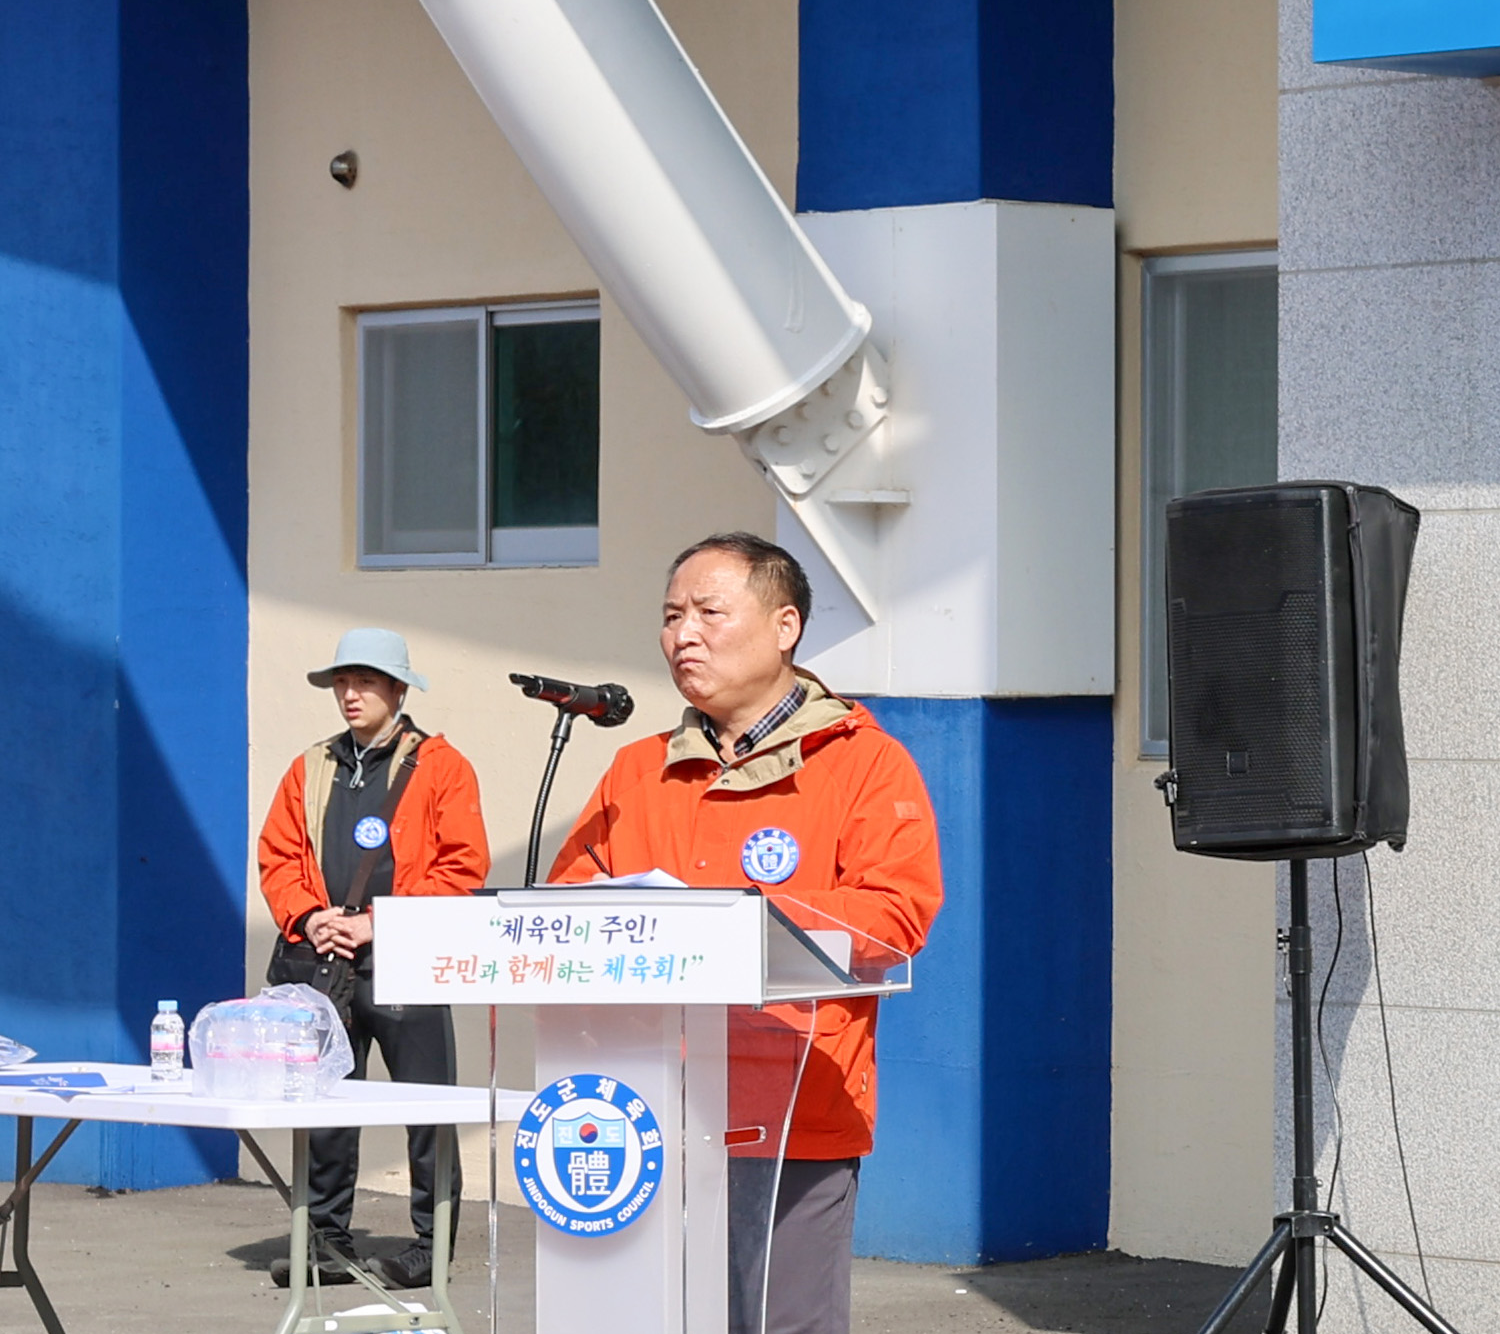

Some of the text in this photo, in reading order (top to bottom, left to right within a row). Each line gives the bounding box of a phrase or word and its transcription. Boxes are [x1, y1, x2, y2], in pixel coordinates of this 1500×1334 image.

[600, 915, 658, 945] 주인!
[431, 954, 499, 985] 군민과
[507, 953, 595, 986] 함께하는
[568, 1150, 611, 1196] 體
[523, 1177, 655, 1232] JINDOGUN SPORTS COUNCIL
